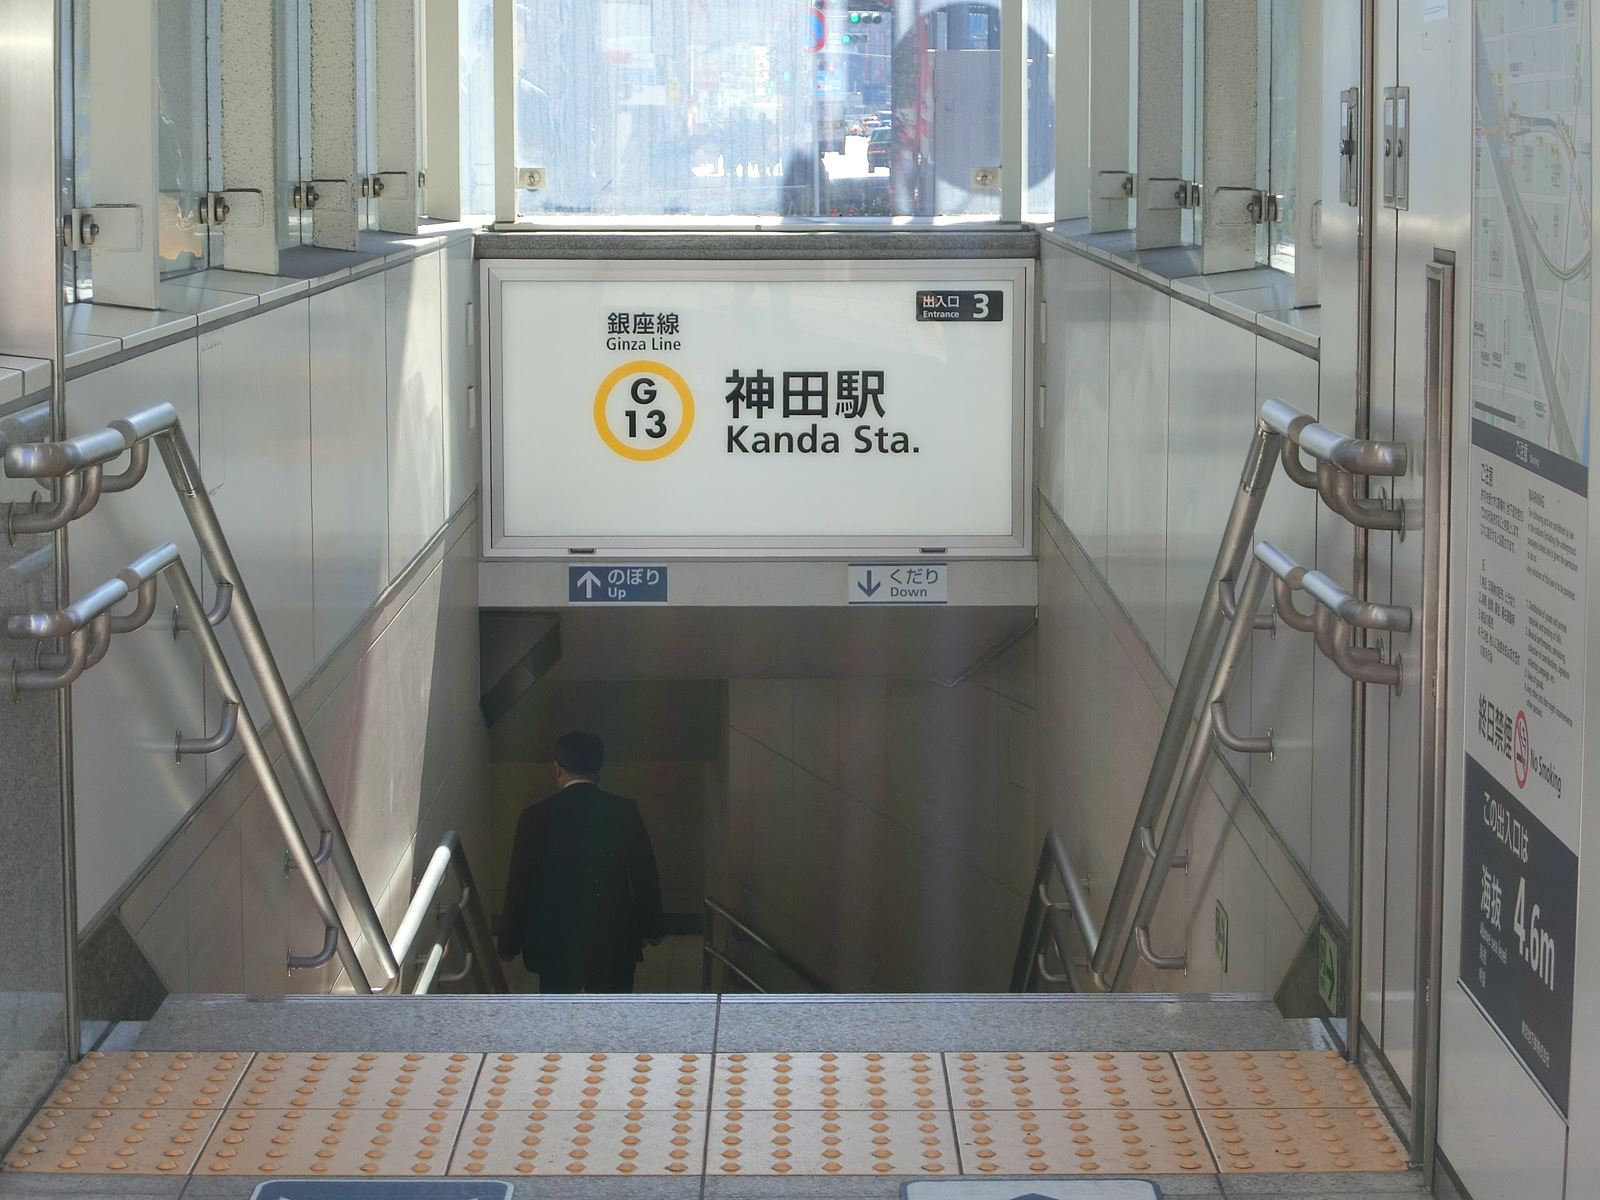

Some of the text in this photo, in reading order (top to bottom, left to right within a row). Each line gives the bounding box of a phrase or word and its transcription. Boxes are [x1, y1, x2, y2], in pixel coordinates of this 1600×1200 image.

[922, 294, 960, 309] 出入口
[922, 310, 960, 319] Entrance
[972, 293, 989, 319] 3
[607, 312, 680, 336] 銀座線
[606, 336, 681, 351] Ginza Line
[630, 377, 658, 405] G
[725, 369, 886, 419] 神田駅
[625, 409, 668, 439] 13
[727, 423, 920, 454] Kanda Sta.
[607, 569, 660, 585] のぼり
[889, 569, 939, 586] くだり
[608, 587, 627, 602] Up
[890, 587, 928, 598] Down
[1478, 692, 1513, 760] 終日禁煙
[1531, 747, 1562, 799] No Smoking
[1483, 791, 1529, 863] この出入口は
[1481, 864, 1502, 931] 海抜
[1513, 876, 1555, 992] 4.6m
